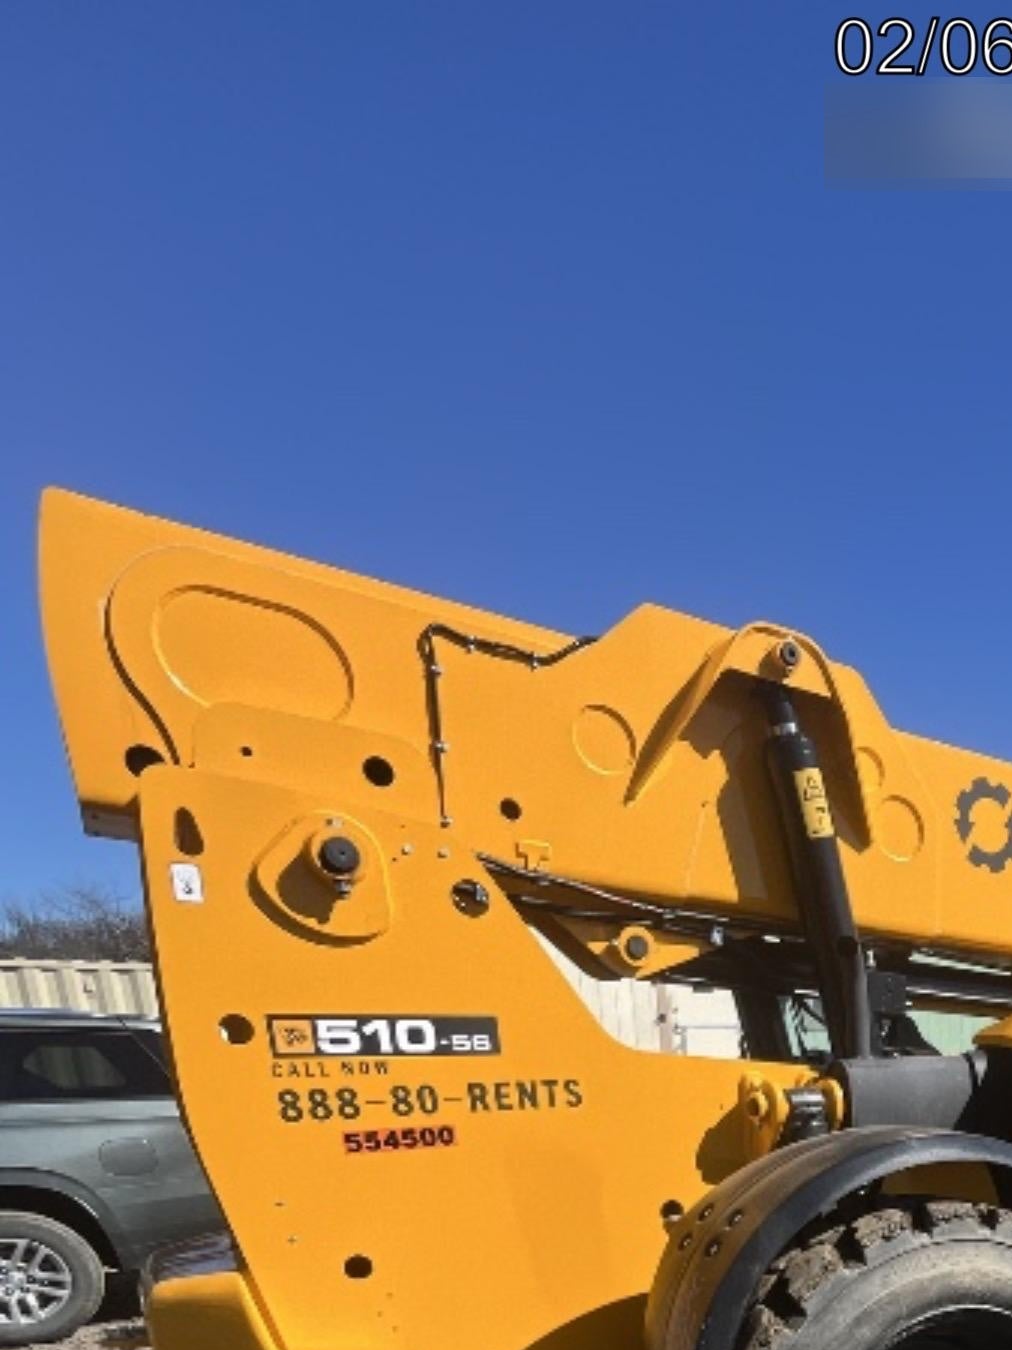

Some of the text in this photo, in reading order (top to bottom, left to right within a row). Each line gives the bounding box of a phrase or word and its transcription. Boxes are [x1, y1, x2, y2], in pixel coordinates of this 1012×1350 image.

[272, 1061, 390, 1078] CALL NOW
[278, 1079, 584, 1123] 888-80-RENTS
[343, 1125, 455, 1153] 554500
